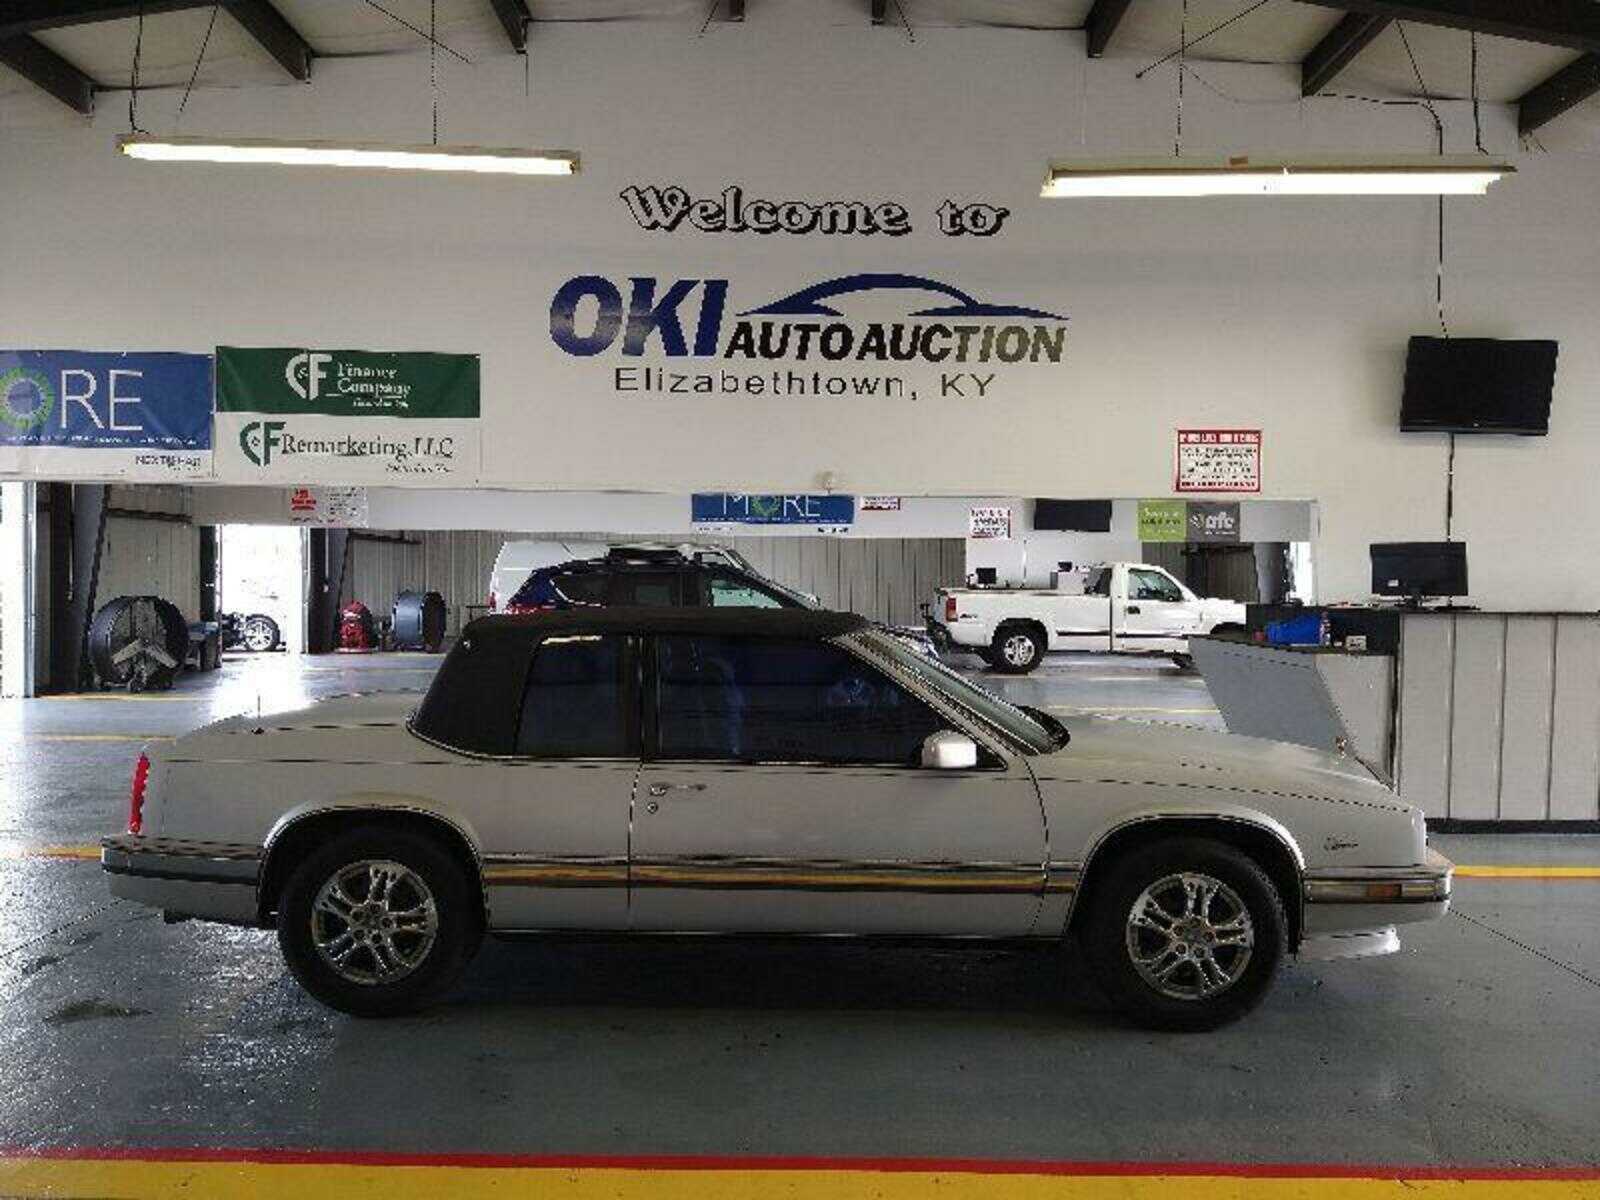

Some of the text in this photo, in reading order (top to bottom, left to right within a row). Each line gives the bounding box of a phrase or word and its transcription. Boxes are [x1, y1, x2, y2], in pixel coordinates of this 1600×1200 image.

[621, 185, 1011, 238] Welcome to
[549, 275, 729, 358] OKI
[338, 361, 398, 379] Finance
[614, 366, 996, 400] Elizabethtown, KY
[338, 377, 412, 399] Company
